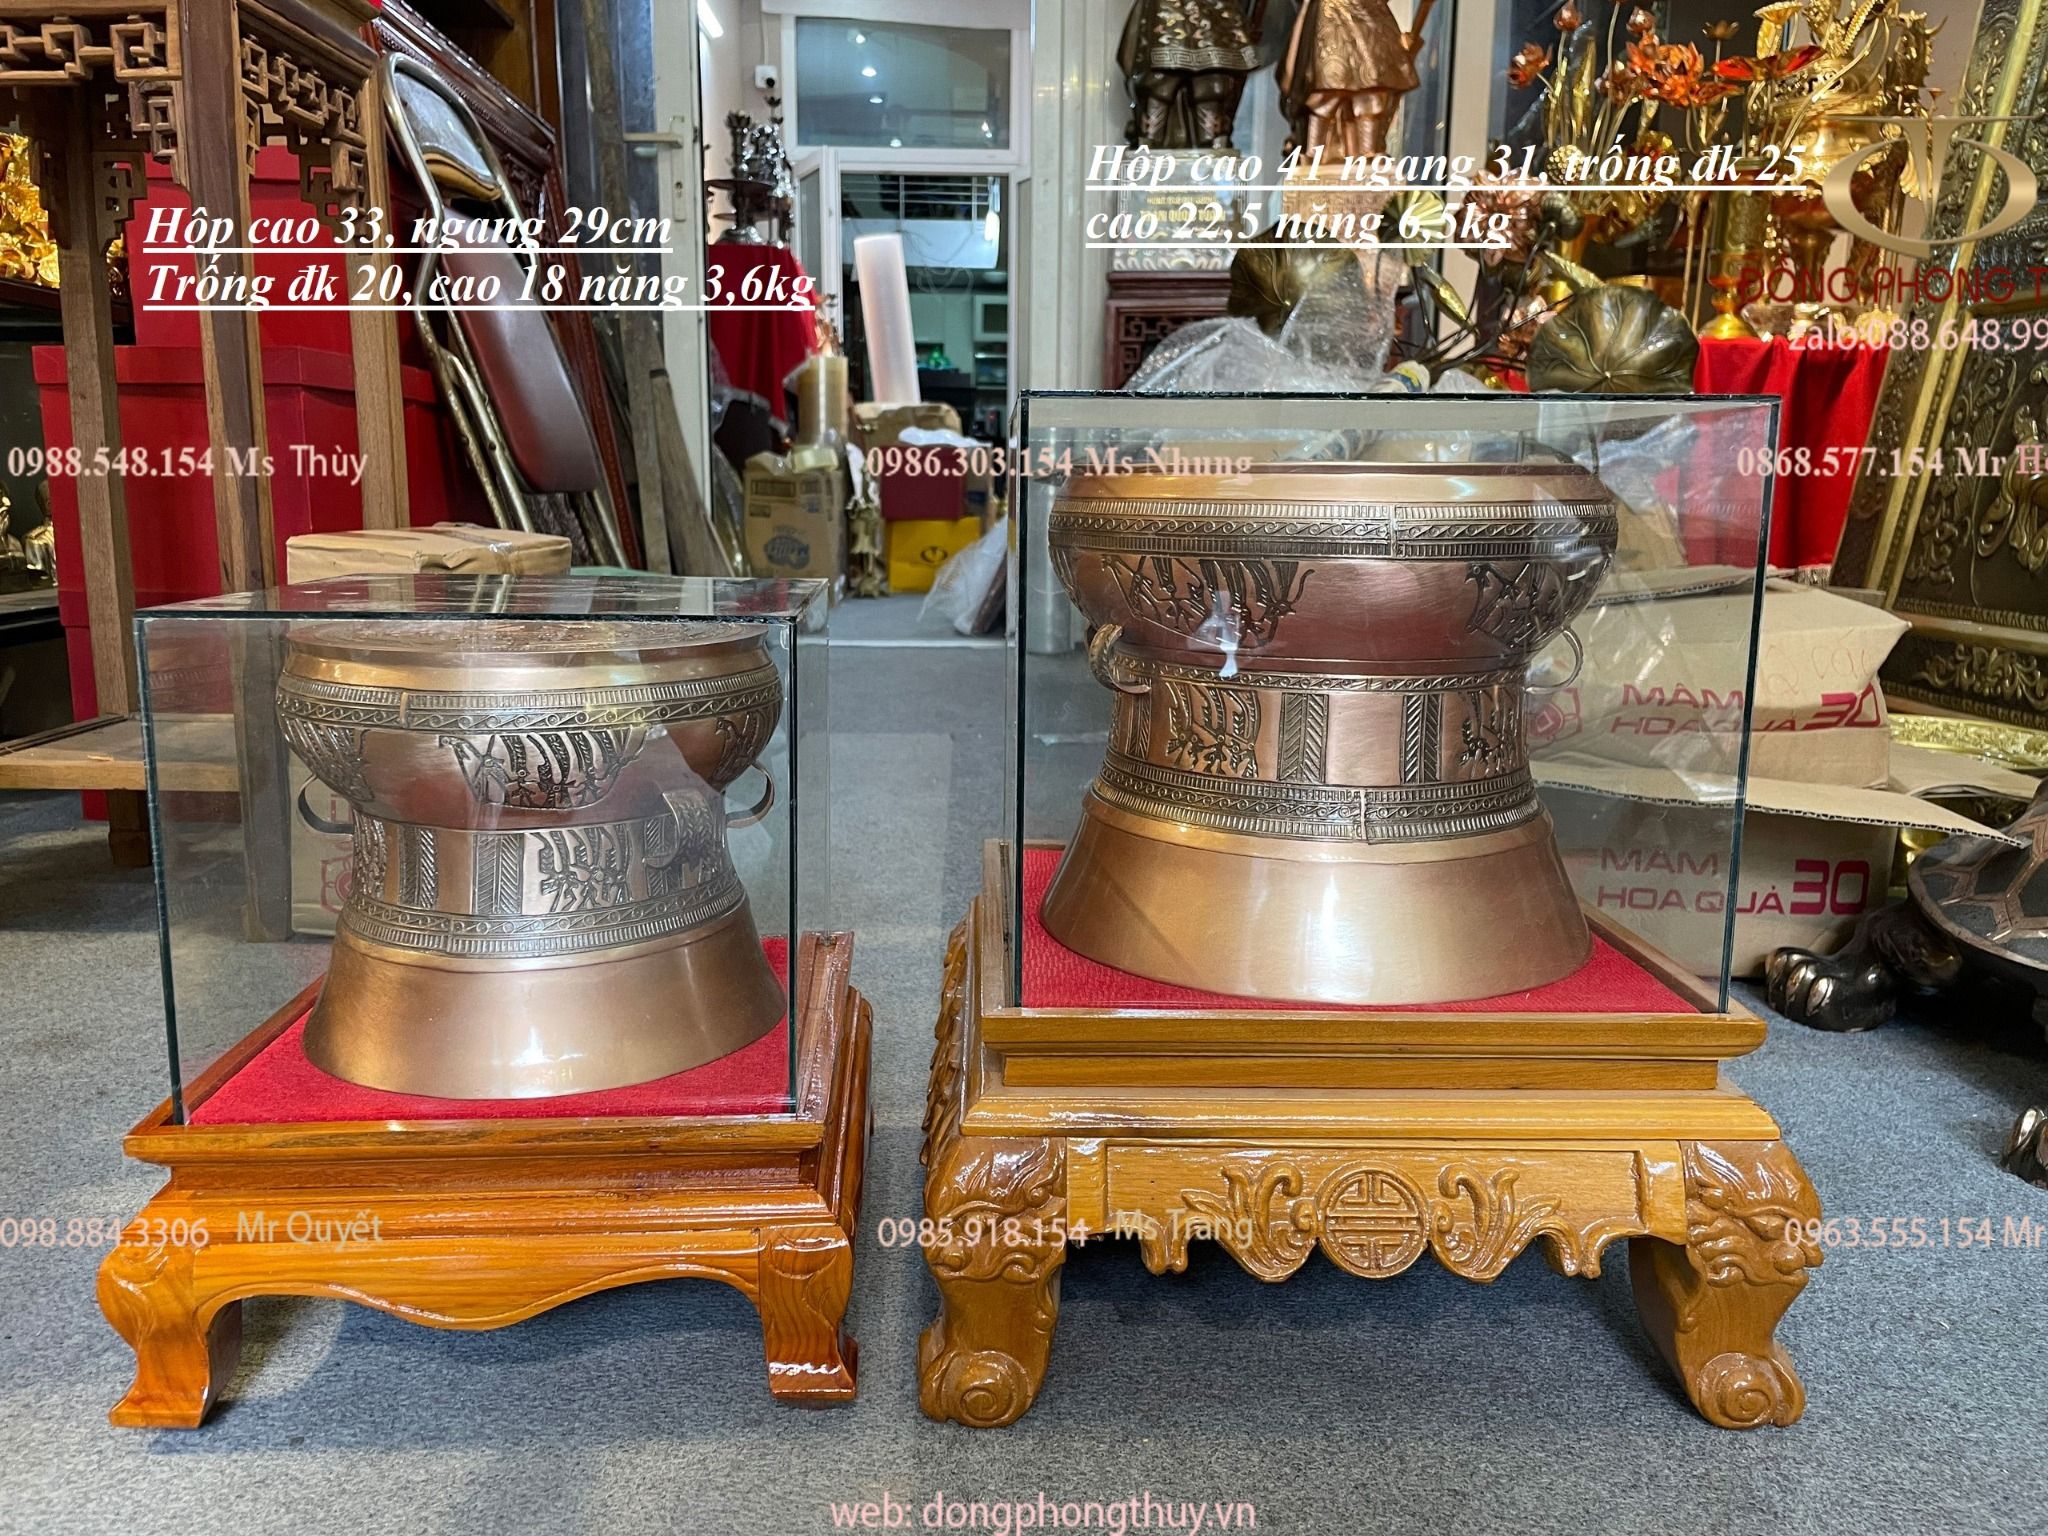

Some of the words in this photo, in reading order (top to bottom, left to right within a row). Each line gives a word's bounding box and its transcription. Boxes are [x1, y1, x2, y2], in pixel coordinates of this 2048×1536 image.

[1801, 682, 1882, 730] 30
[1596, 885, 1687, 912] HOA
[1694, 884, 1786, 916] QUẢ
[1789, 858, 1870, 916] 30
